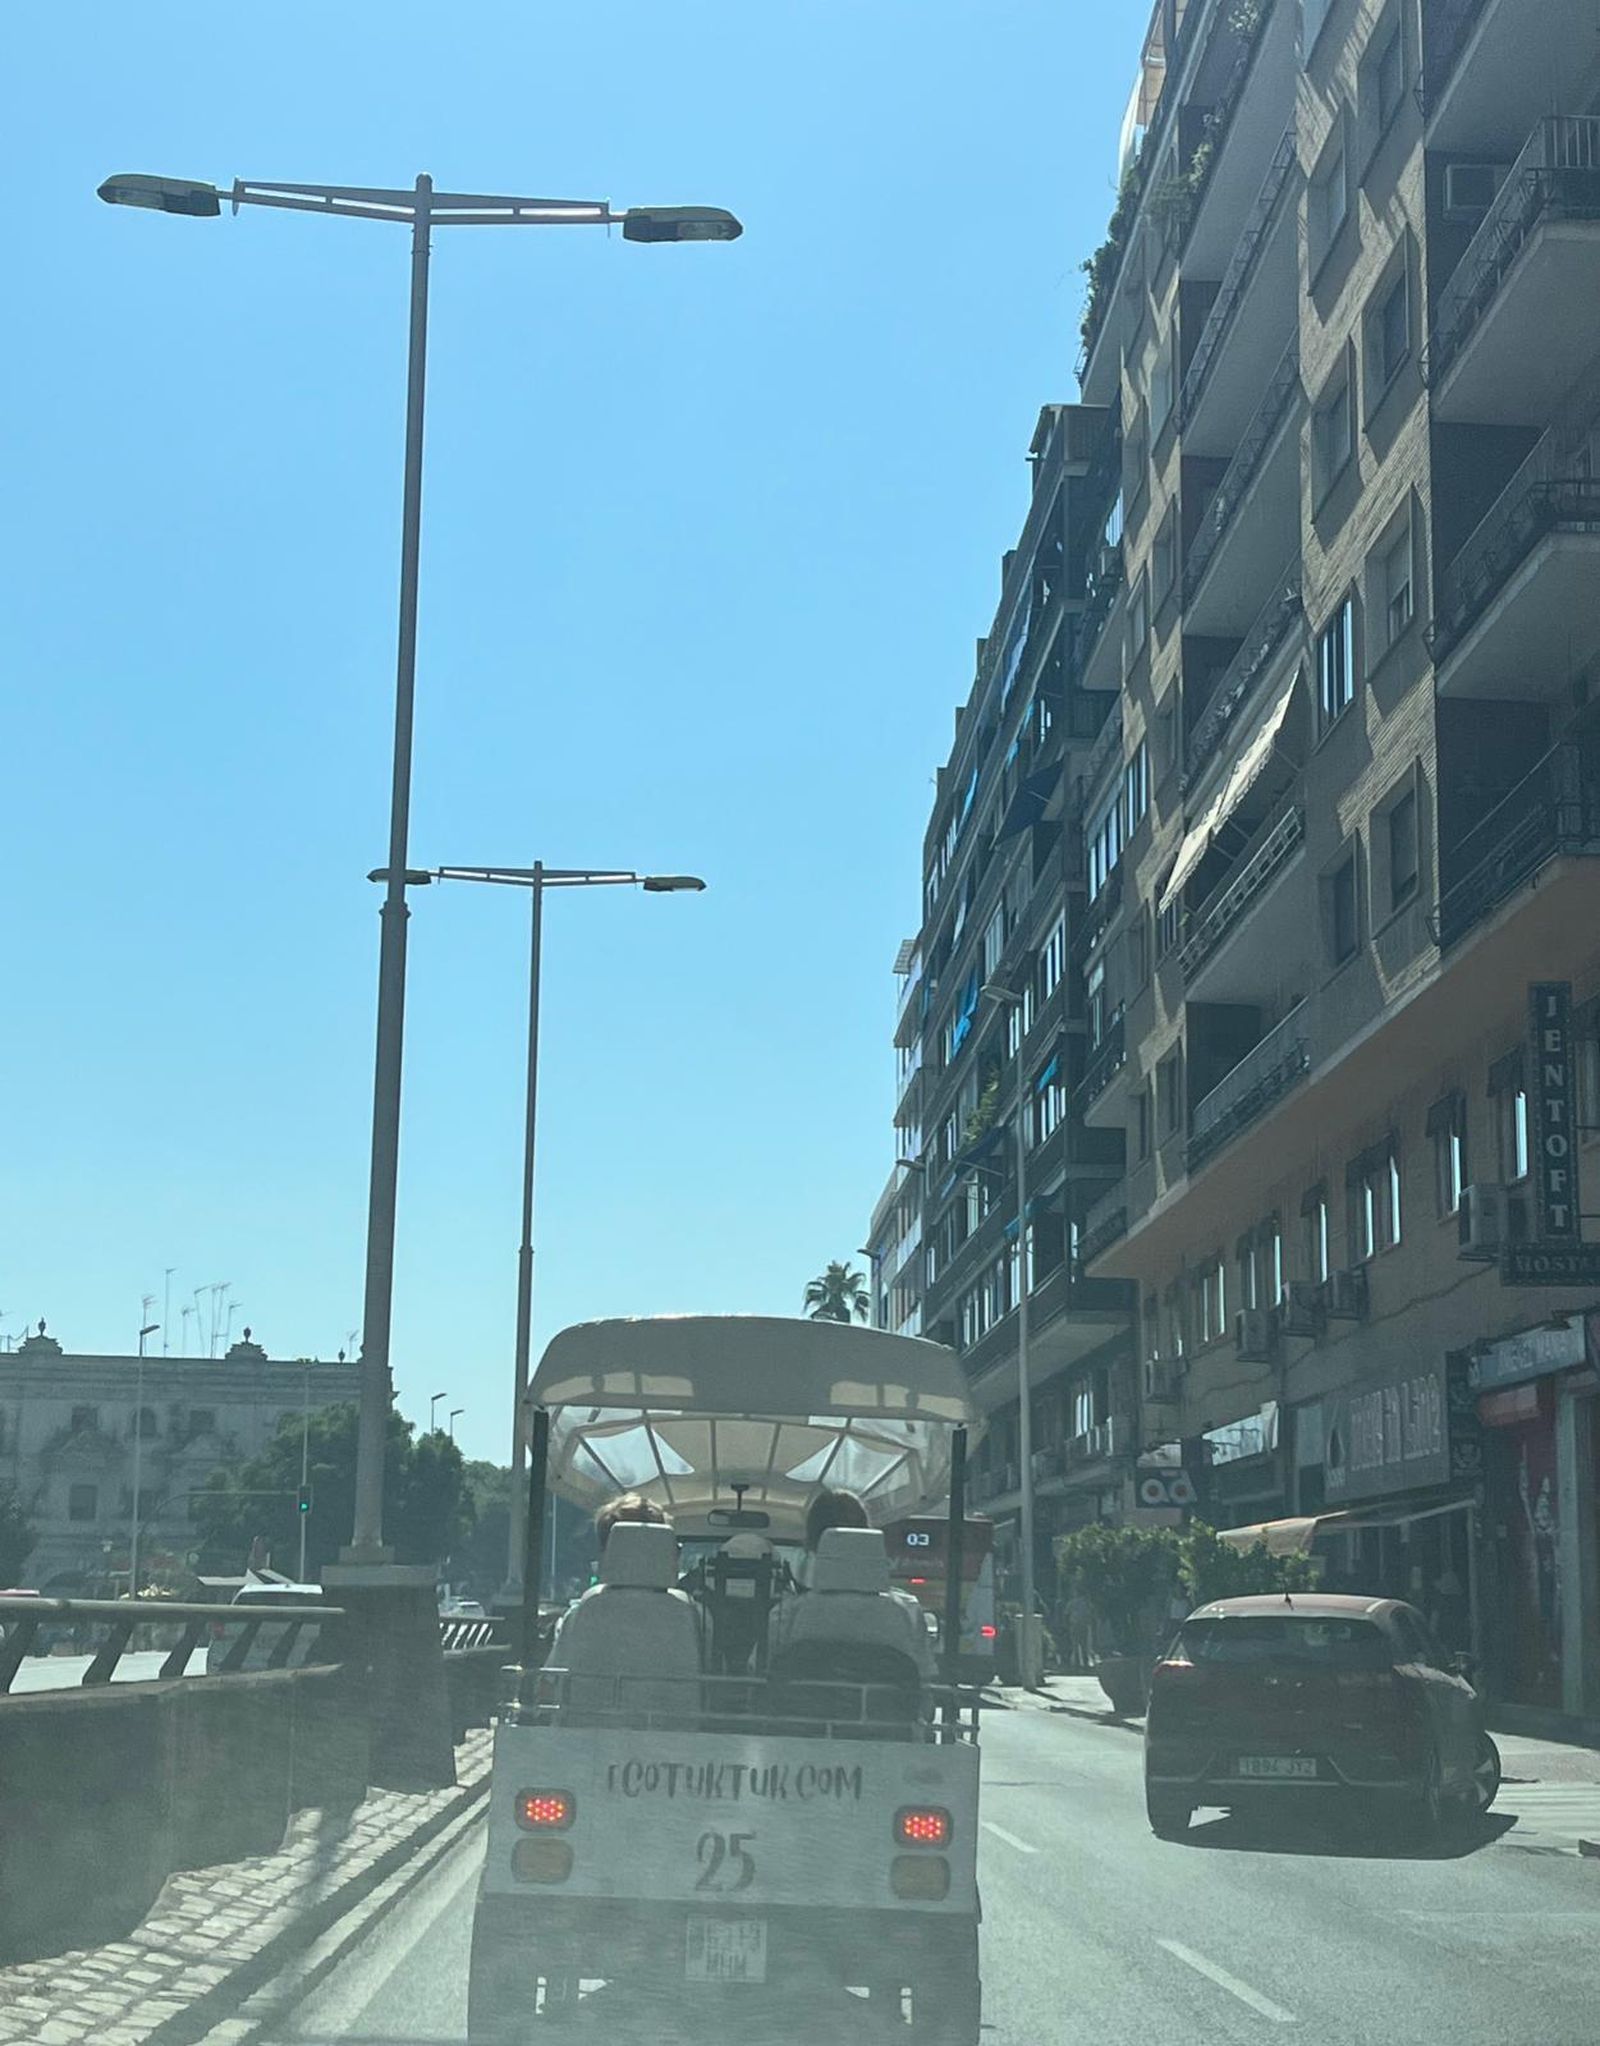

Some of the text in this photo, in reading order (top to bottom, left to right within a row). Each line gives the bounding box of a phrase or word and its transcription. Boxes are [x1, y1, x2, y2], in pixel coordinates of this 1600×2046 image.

[1543, 995, 1569, 1229] JENTOFT
[906, 1533, 930, 1546] 03
[694, 1831, 757, 1893] 25
